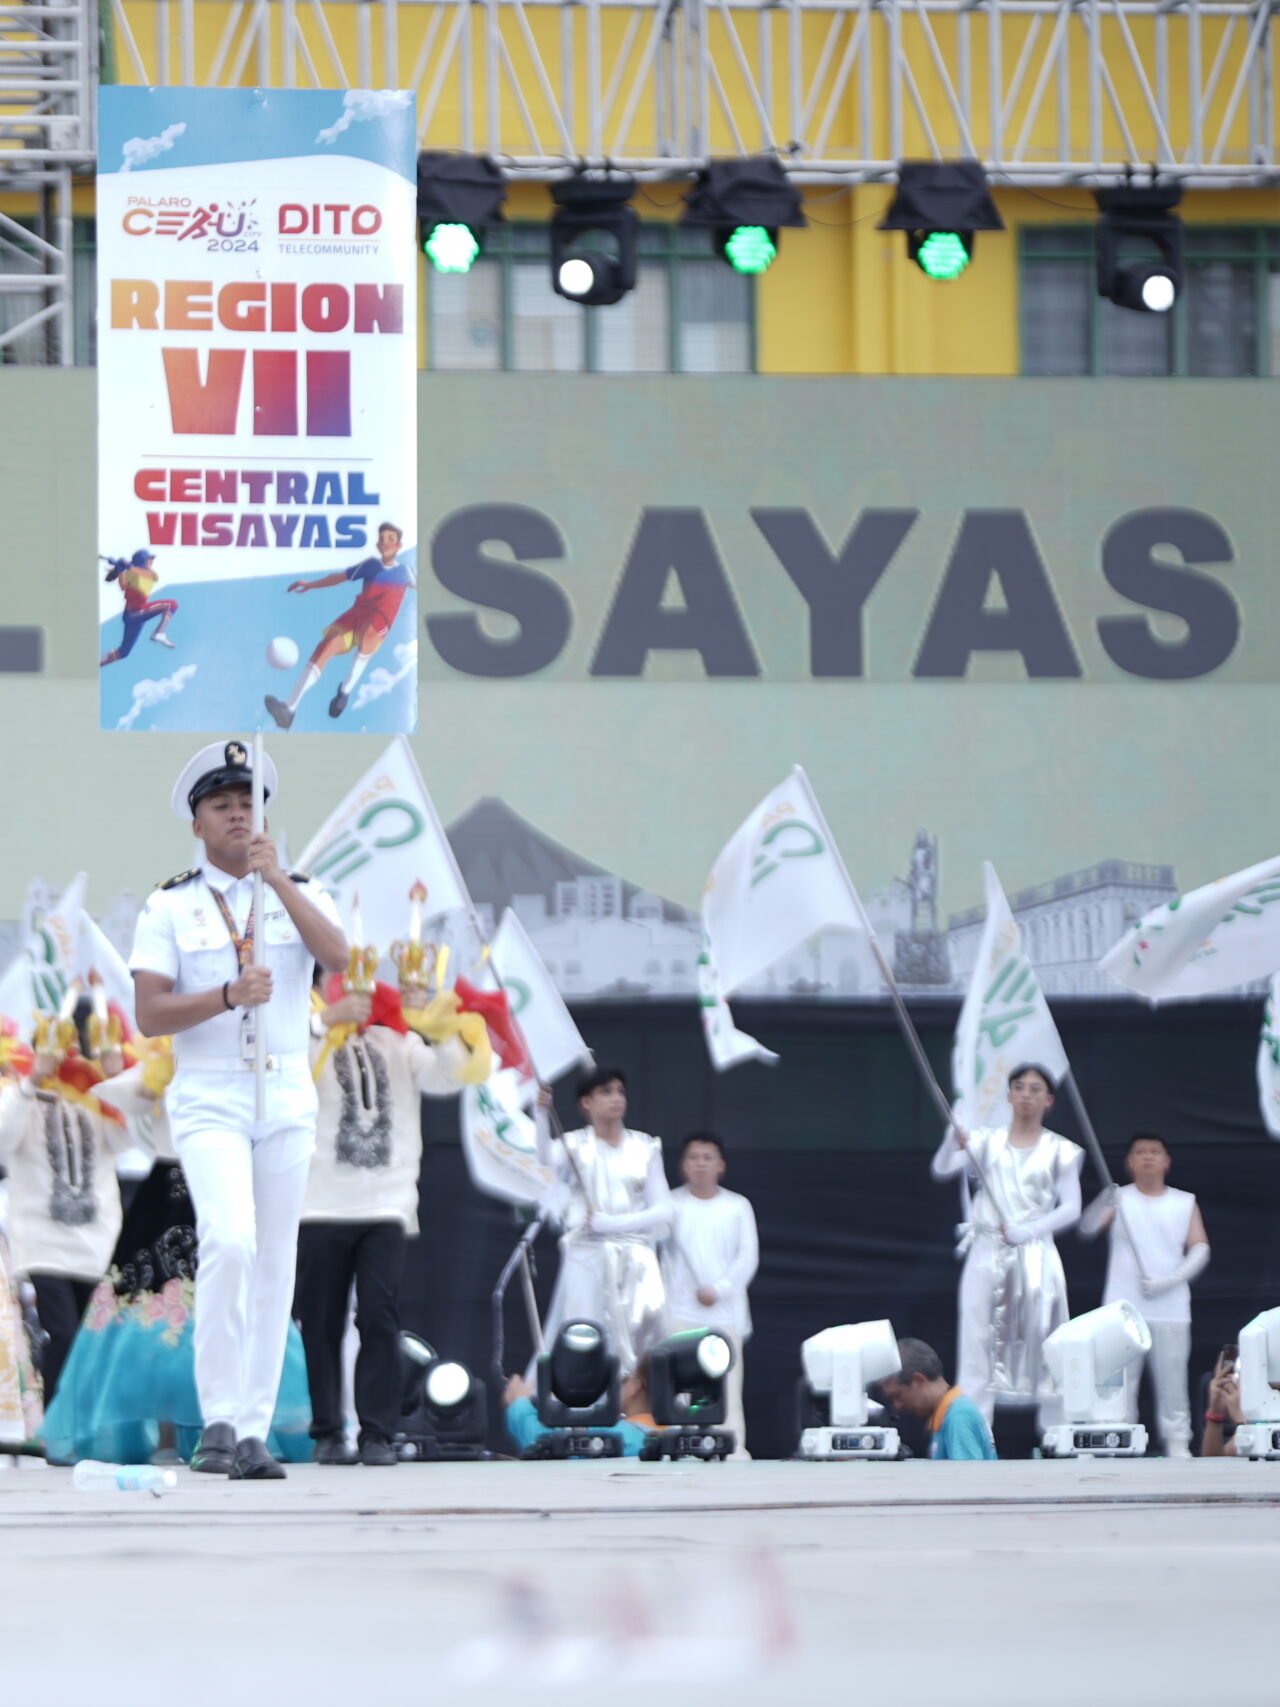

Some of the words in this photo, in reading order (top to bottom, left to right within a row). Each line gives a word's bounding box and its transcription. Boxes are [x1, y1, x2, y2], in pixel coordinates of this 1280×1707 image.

[127, 196, 192, 208] PALARO
[278, 203, 383, 235] DITO
[207, 239, 260, 252] 2024
[278, 243, 380, 255] TELECOMMUNITY
[110, 278, 404, 334] REGION
[161, 346, 352, 437] VII
[133, 468, 380, 506] CENTRAL
[146, 511, 368, 548] VISAYAS
[424, 501, 1241, 681] SAYAS
